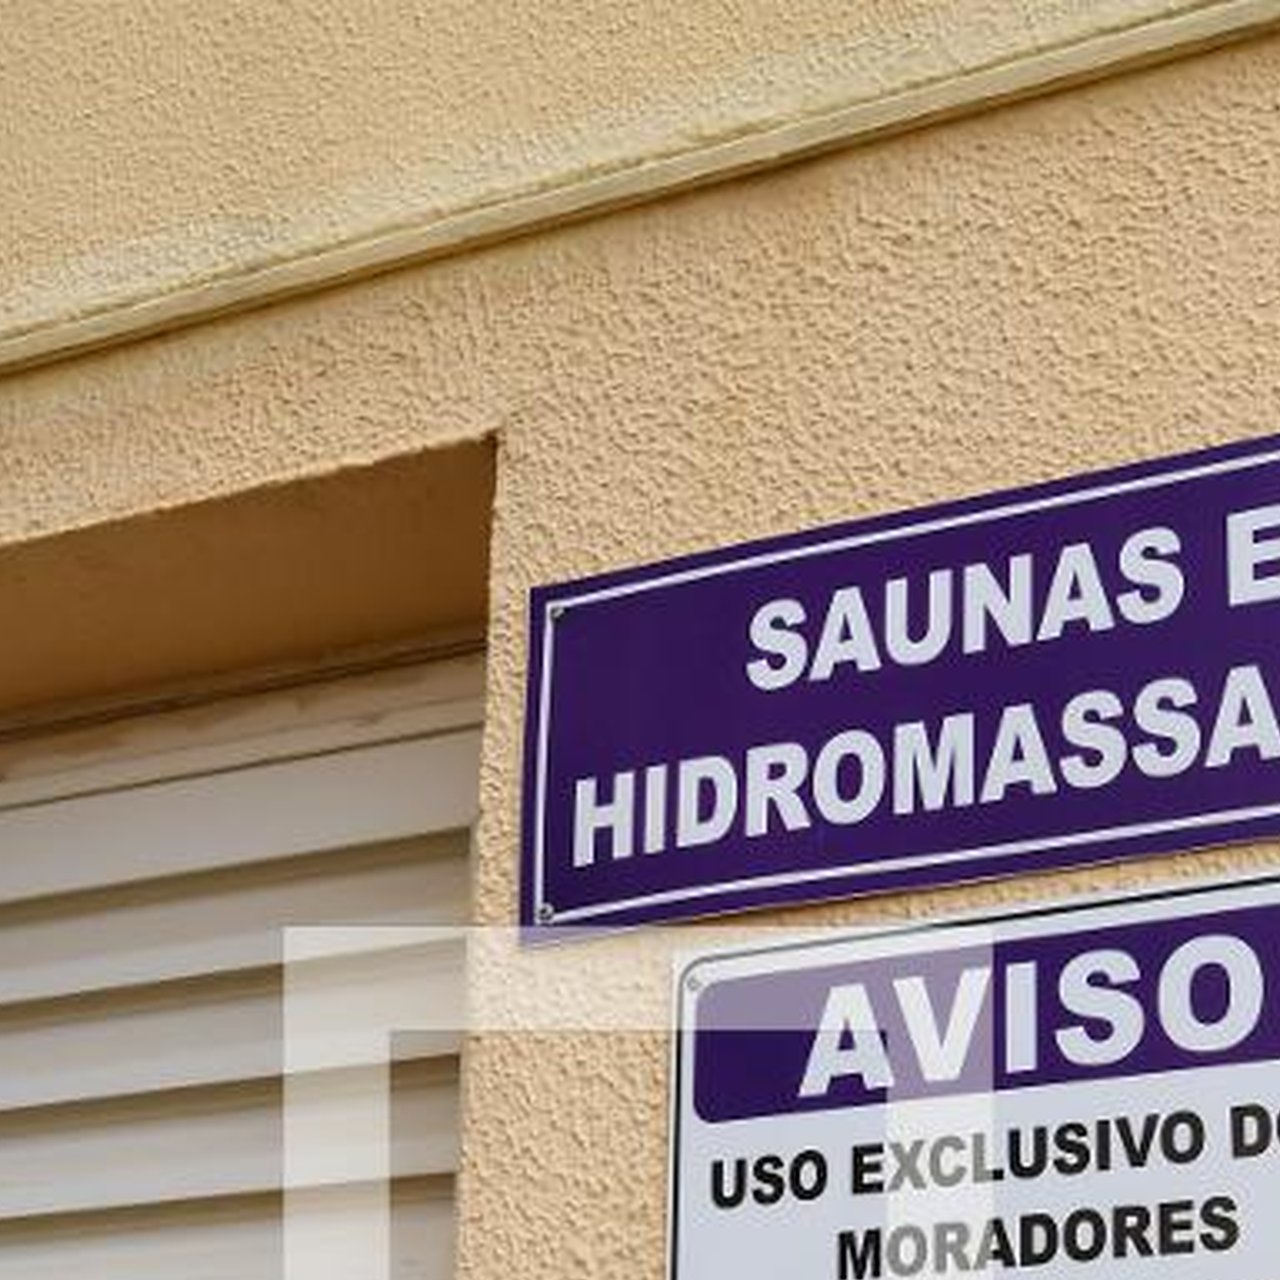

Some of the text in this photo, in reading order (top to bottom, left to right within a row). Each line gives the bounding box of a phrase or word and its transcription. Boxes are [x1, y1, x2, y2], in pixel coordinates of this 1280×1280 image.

[745, 526, 1185, 691] SAUNAS
[799, 935, 1264, 1097] AVISO
[709, 1147, 829, 1211] USO
[849, 1108, 1207, 1197] EXCLUSIVO
